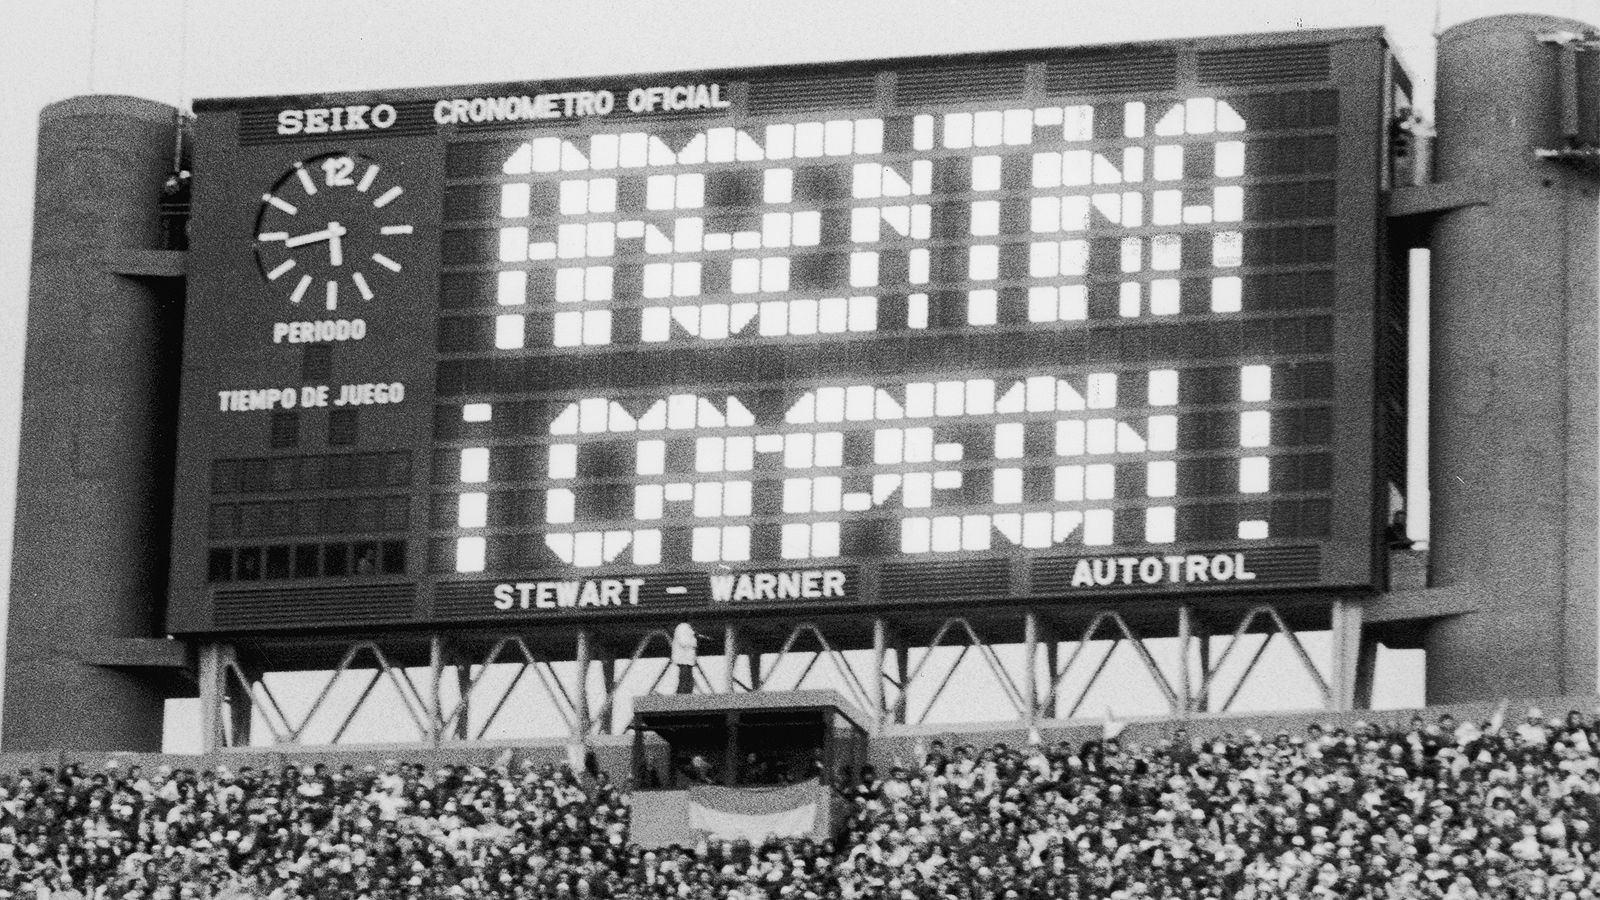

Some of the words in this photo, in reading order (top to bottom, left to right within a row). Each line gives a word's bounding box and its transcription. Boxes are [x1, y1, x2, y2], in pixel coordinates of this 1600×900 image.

[277, 104, 397, 135] SEIKO
[432, 90, 615, 125] CRONOMETRO
[626, 83, 731, 113] OFICIAL
[321, 156, 355, 187] 12
[495, 97, 1247, 350] ARGENTINA
[273, 318, 366, 344] PERIODO
[218, 387, 297, 412] TIEMPO
[300, 385, 329, 408] DE
[334, 381, 405, 407] JUEGO
[1071, 553, 1256, 588] AUTOTROL
[494, 578, 645, 610] STEWART
[710, 569, 846, 602] WARNER
